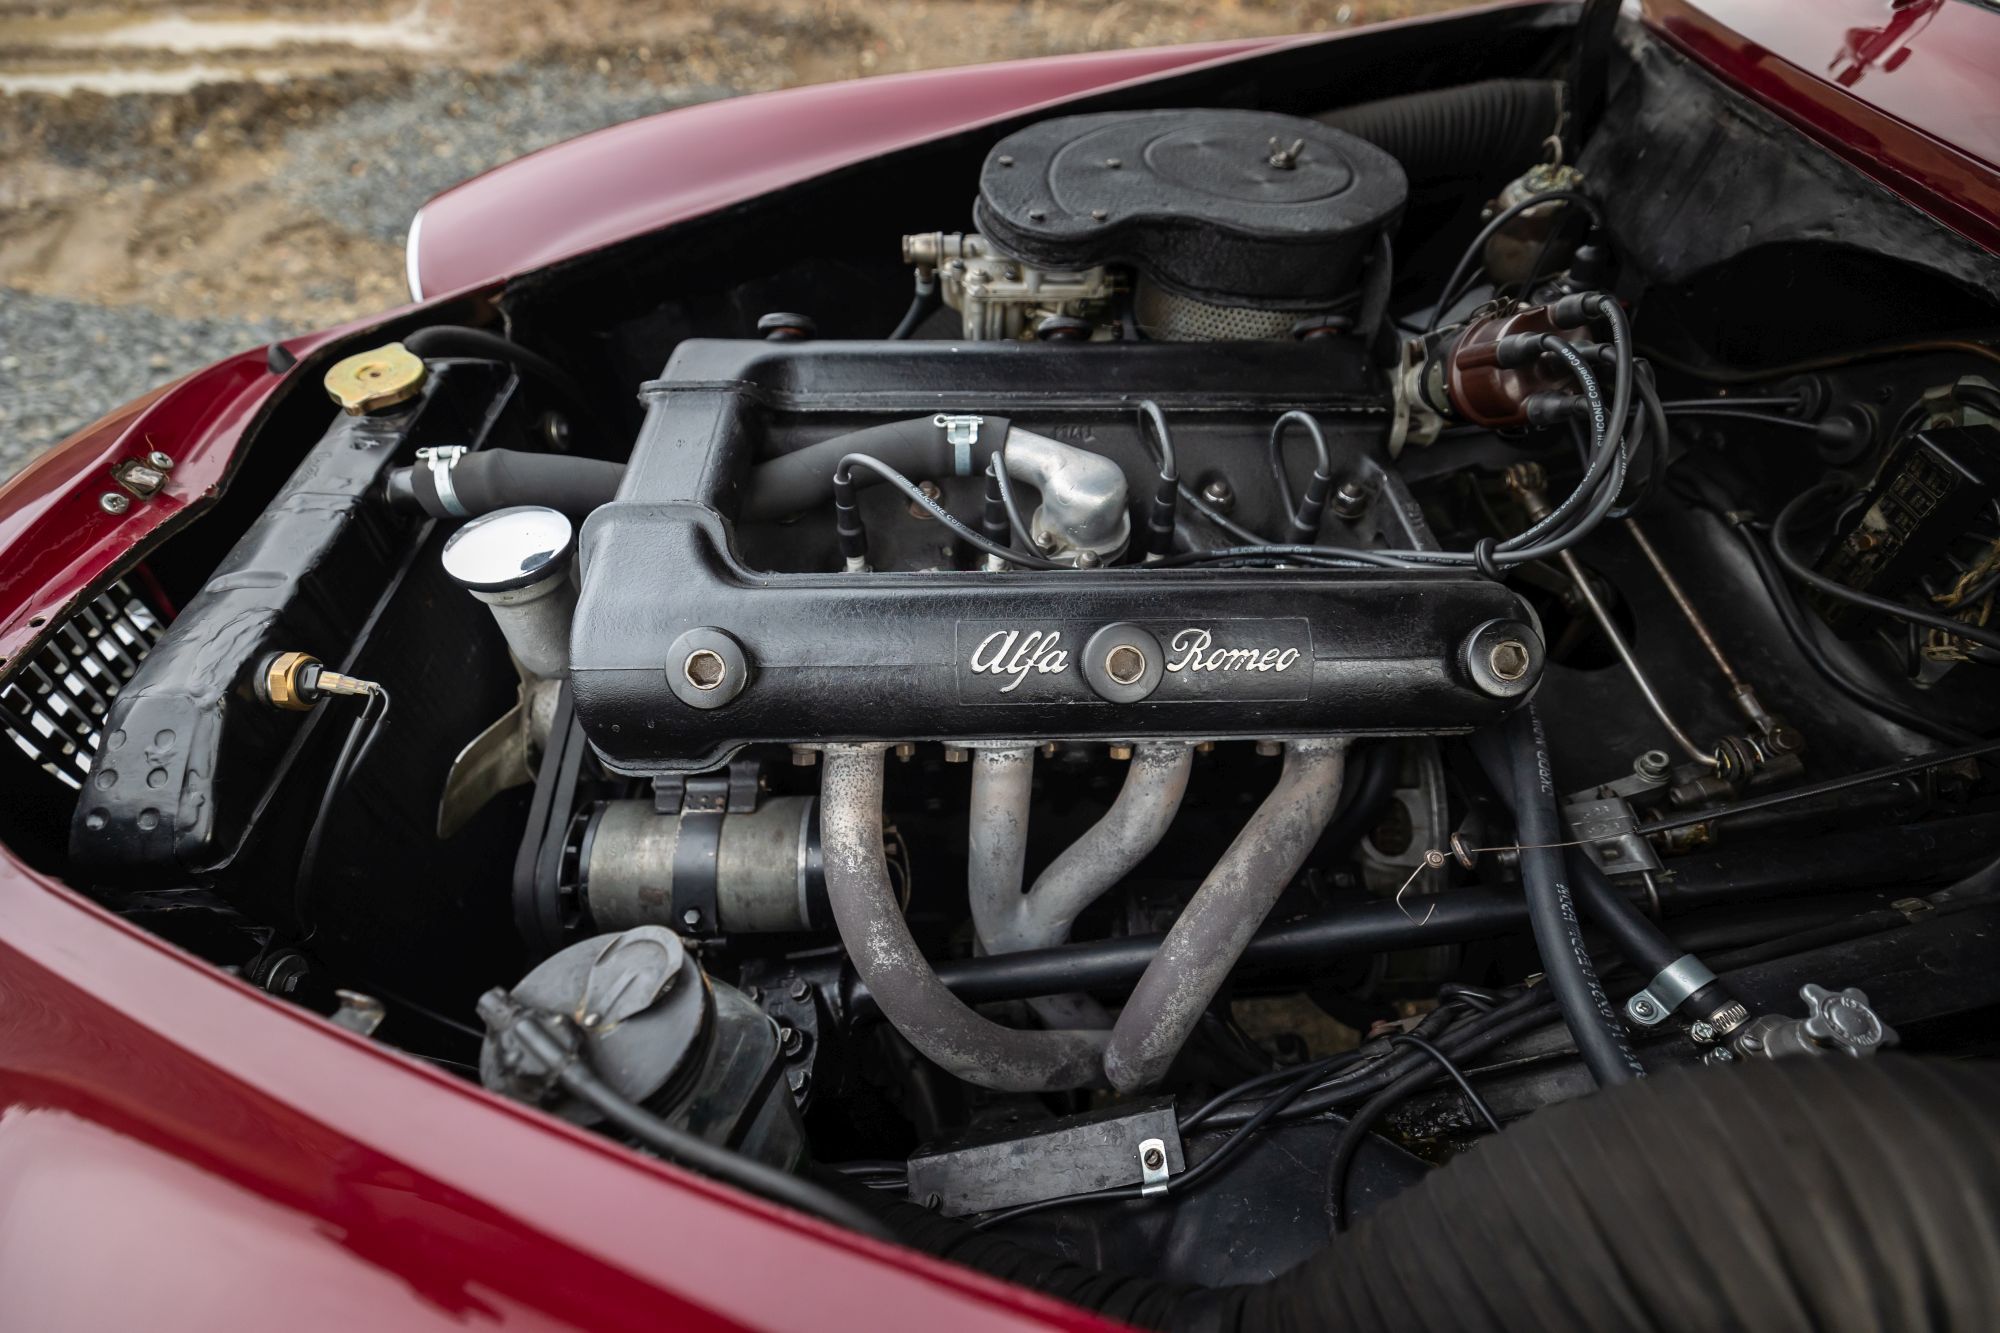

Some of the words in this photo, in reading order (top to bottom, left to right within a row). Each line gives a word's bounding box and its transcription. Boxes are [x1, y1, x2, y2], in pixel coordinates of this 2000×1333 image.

[1561, 347, 1581, 366] Core
[1578, 366, 1599, 399] Copper
[912, 486, 947, 516] SILICONE
[970, 629, 1069, 693] Alfa
[1166, 627, 1301, 673] Romeo
